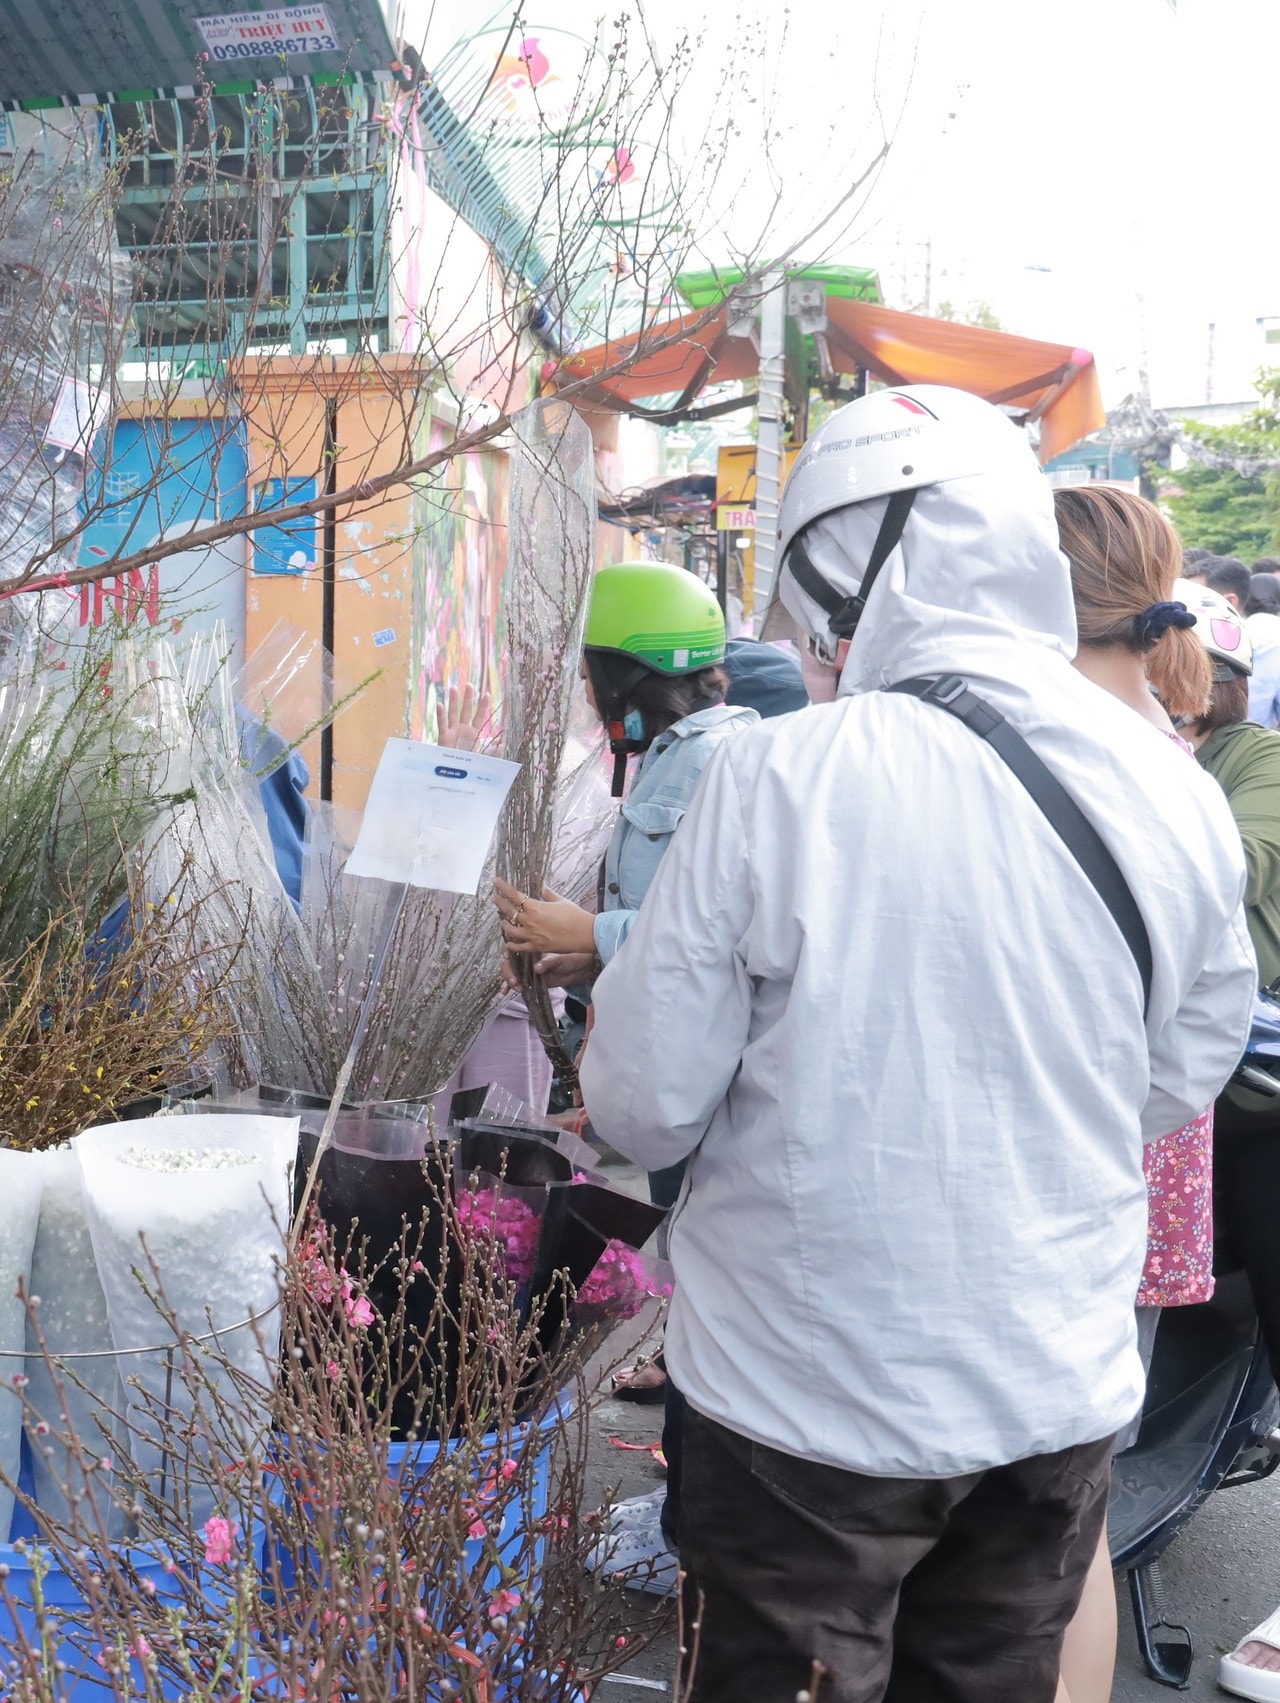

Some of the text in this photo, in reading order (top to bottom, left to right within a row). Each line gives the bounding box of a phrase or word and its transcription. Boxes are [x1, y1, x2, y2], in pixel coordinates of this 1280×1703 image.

[236, 21, 286, 40] TRIỆU
[292, 18, 326, 34] HUY
[214, 35, 335, 59] 0908886733
